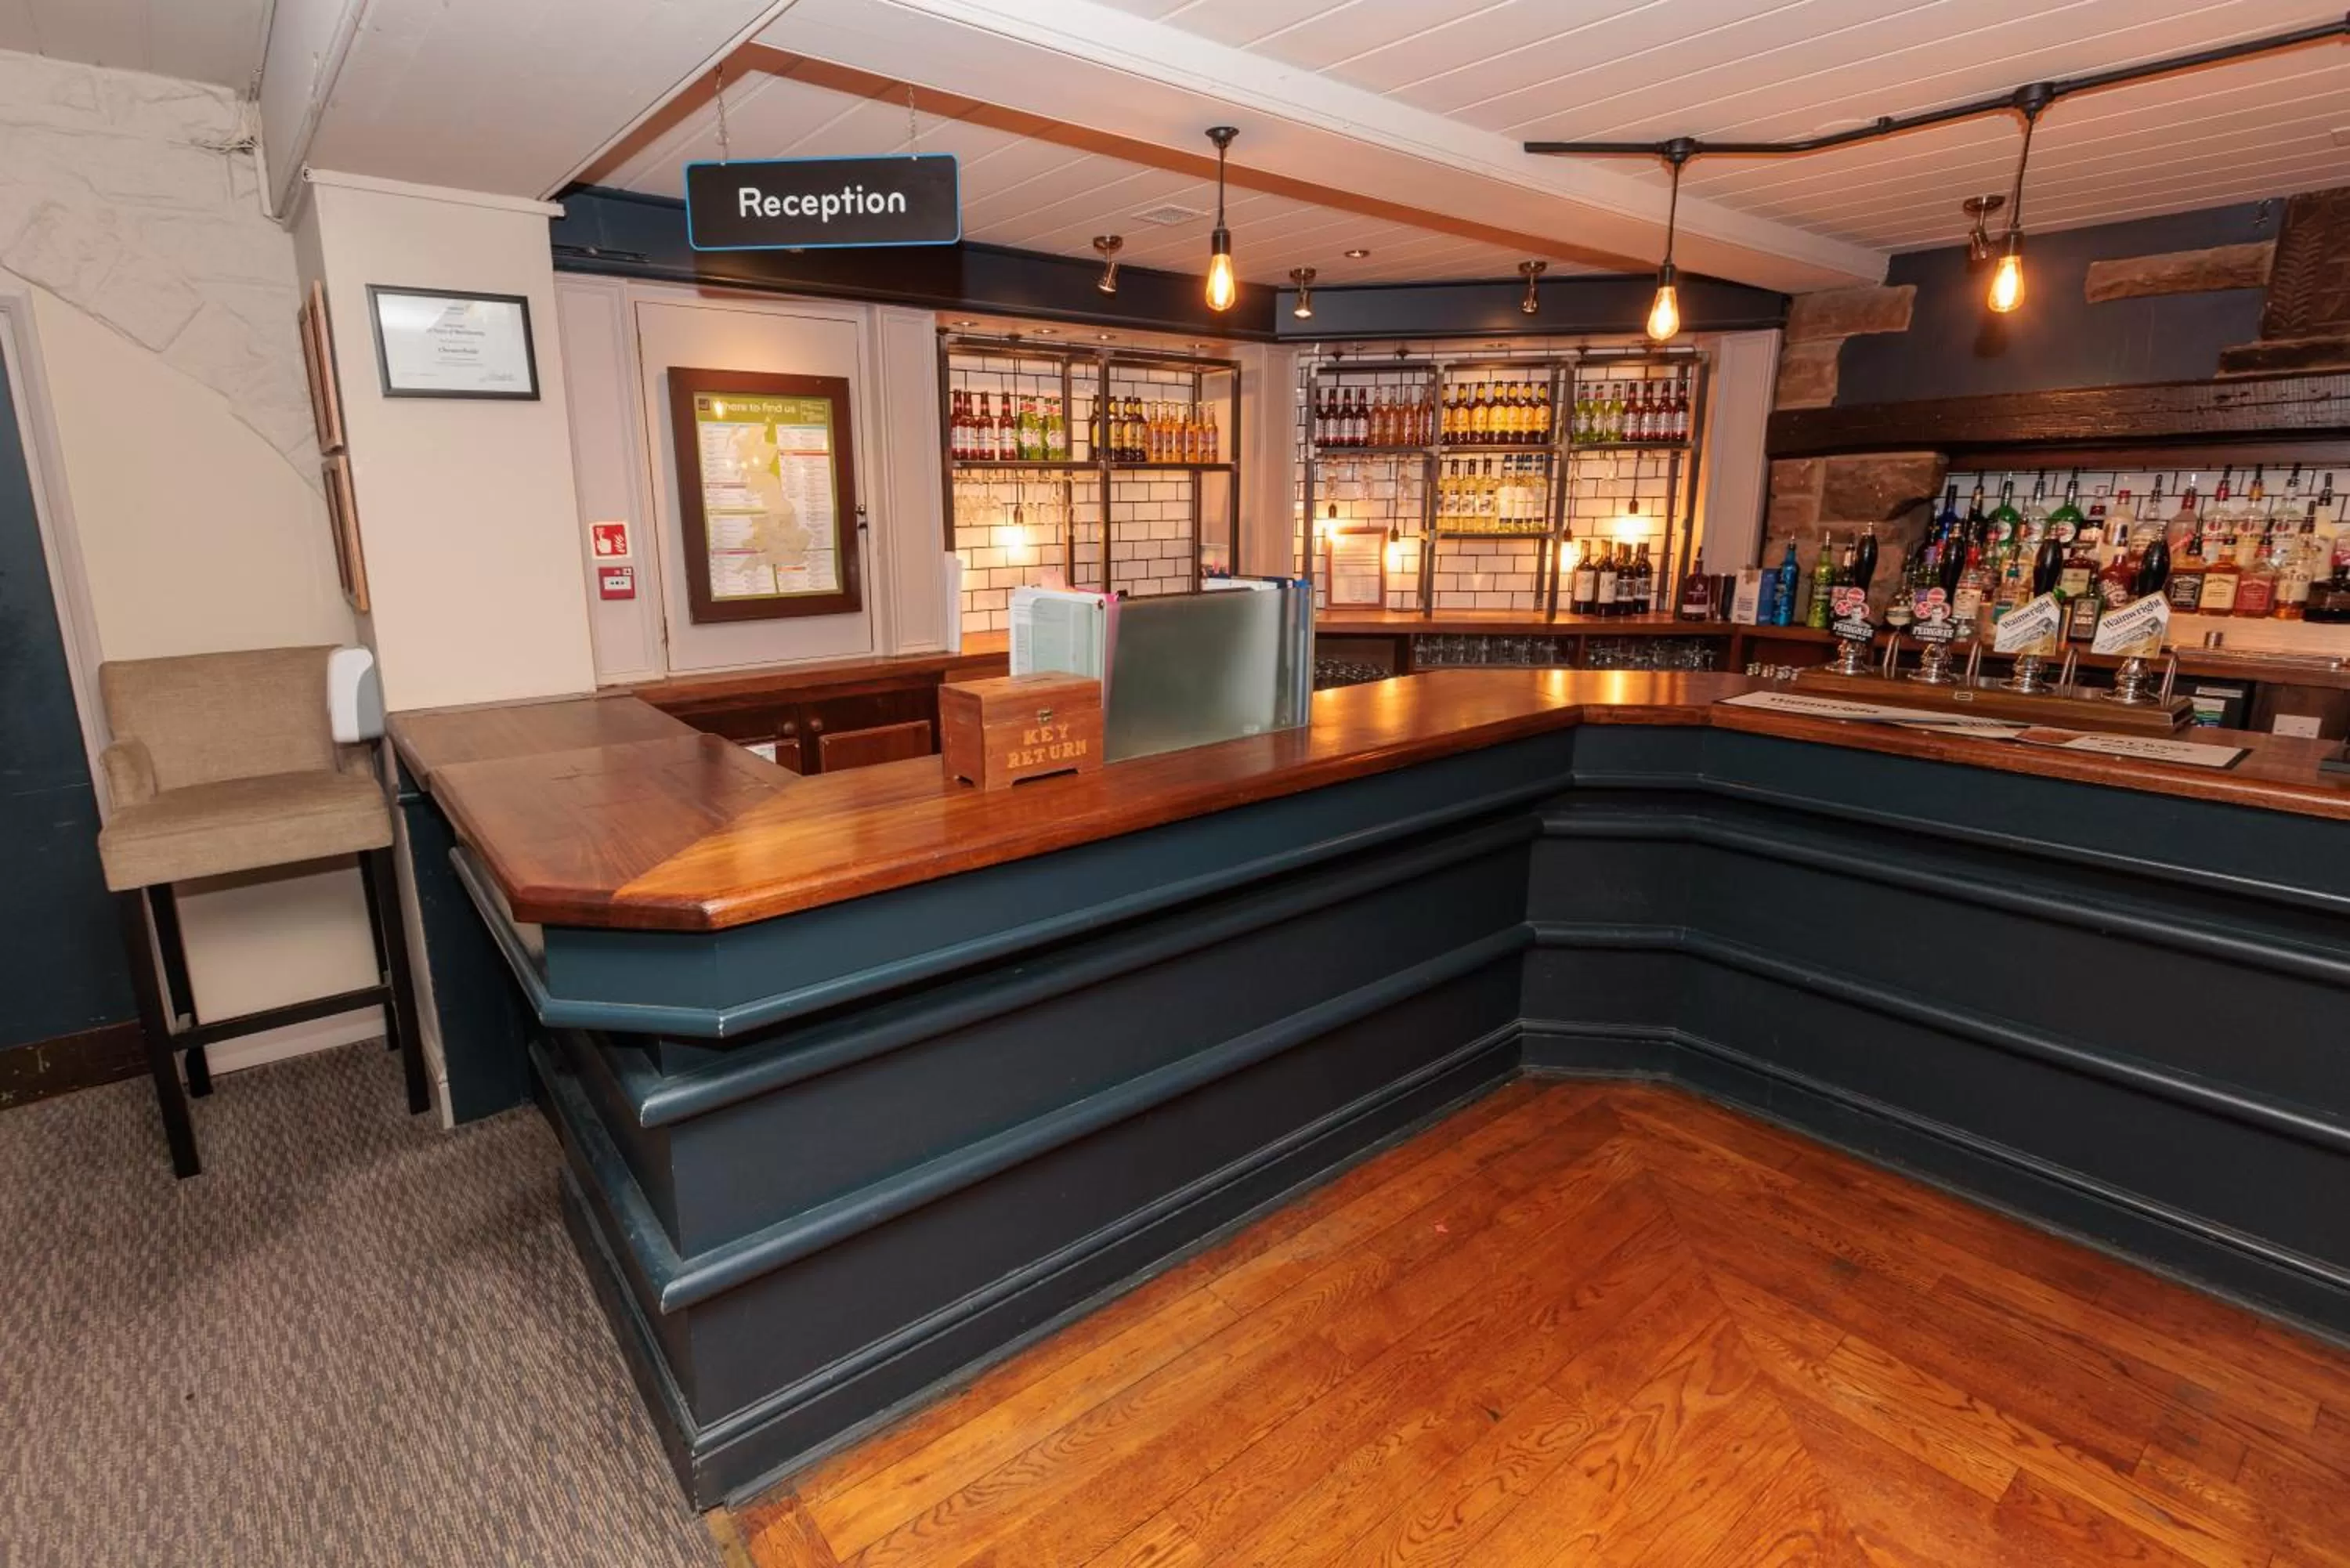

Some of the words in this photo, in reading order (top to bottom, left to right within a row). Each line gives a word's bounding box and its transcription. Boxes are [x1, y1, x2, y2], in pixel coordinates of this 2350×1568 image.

[738, 185, 906, 223] Reception
[750, 403, 761, 412] to
[763, 402, 782, 413] find
[785, 405, 796, 414] us
[2001, 600, 2052, 629] Wainwright
[2102, 599, 2161, 629] Wainwright
[1022, 722, 1070, 746] KEY
[1007, 739, 1087, 768] RETURN
